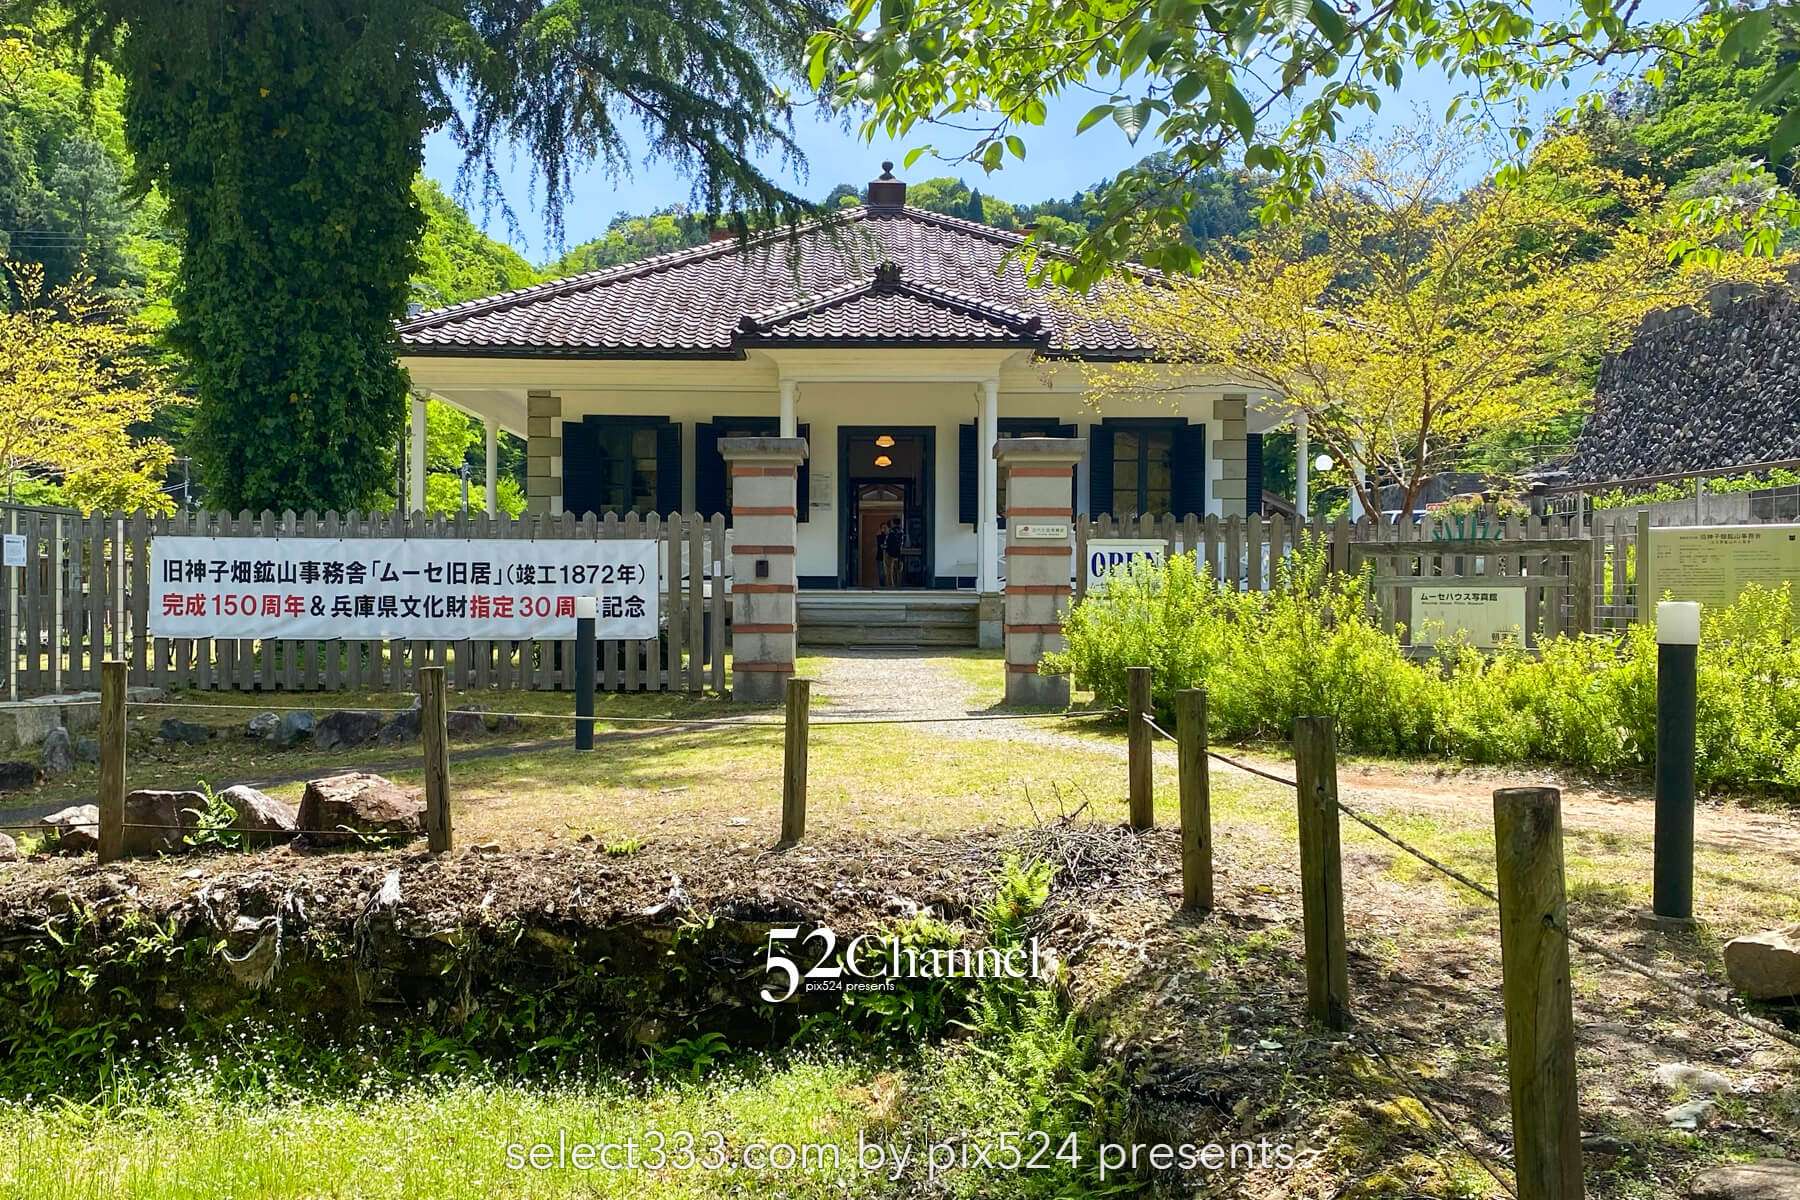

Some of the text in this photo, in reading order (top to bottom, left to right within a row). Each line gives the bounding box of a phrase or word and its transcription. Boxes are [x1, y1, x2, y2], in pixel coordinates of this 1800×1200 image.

[162, 593, 646, 618] 完成150周年&兵庫県文化財指定30周記念
